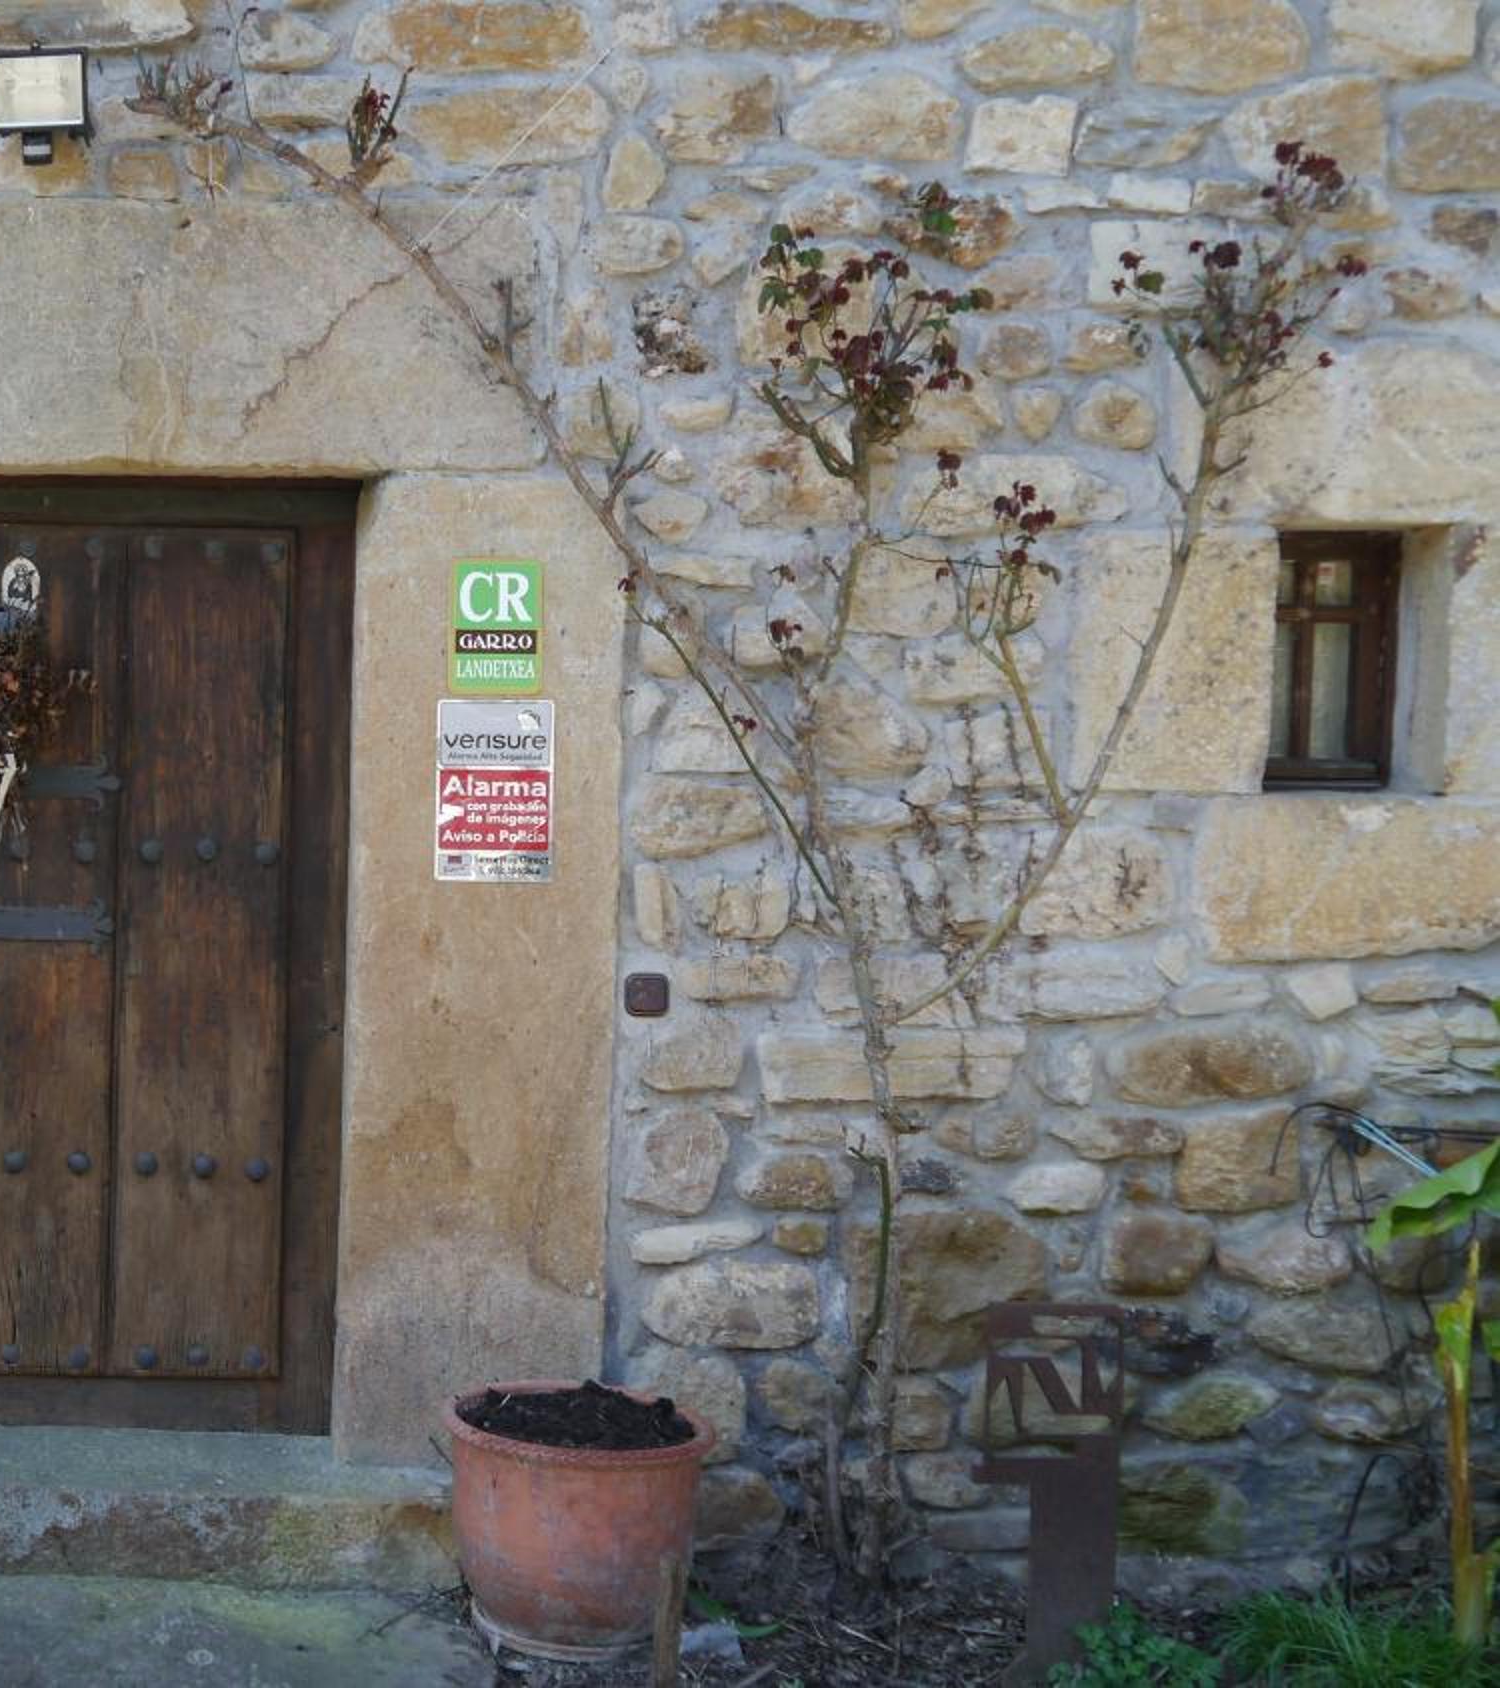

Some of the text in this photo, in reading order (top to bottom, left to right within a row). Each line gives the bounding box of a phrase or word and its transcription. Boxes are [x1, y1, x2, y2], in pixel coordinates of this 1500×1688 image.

[460, 571, 533, 623] CR
[459, 633, 533, 650] GARRO
[456, 659, 535, 679] LANDETXEA
[444, 733, 547, 749] verisure
[442, 775, 547, 797] Alarma
[467, 802, 487, 811] con
[467, 812, 483, 823] de
[442, 829, 483, 843] Aviso
[487, 833, 495, 842] a
